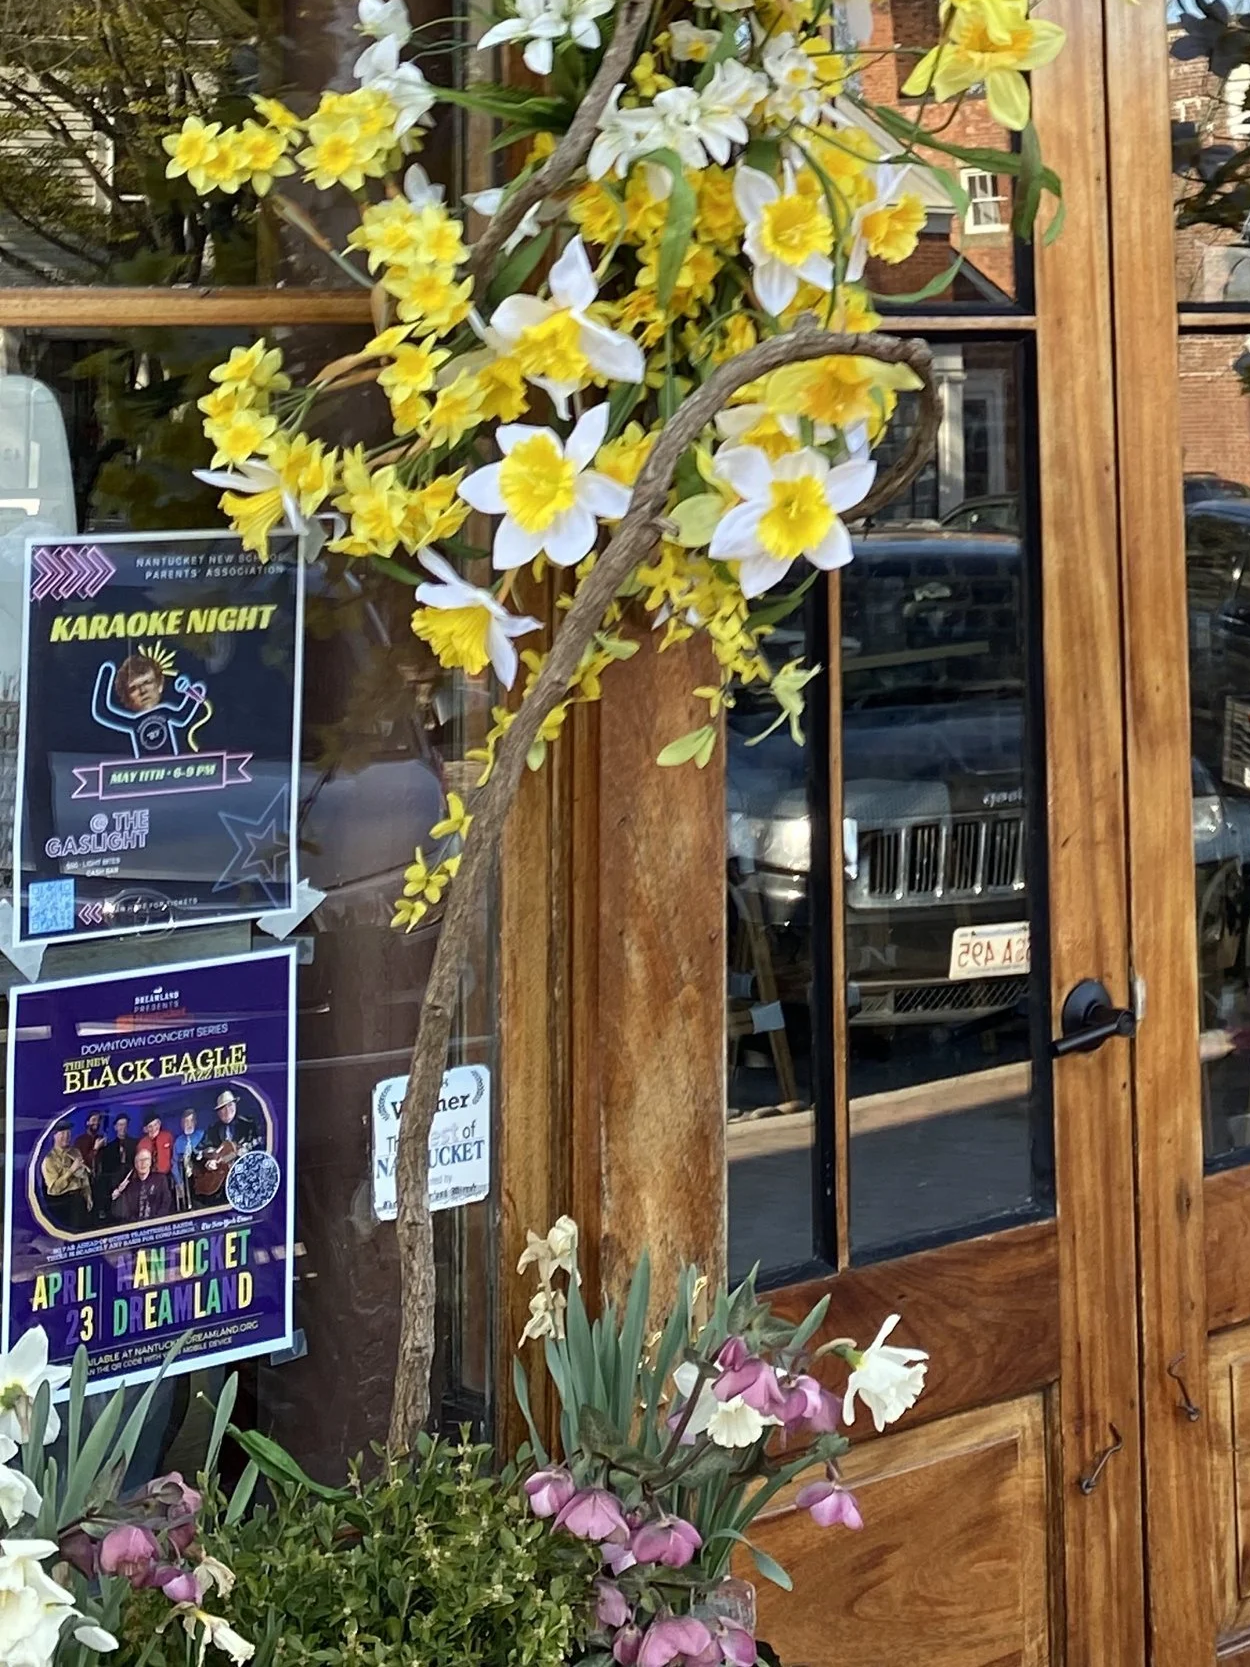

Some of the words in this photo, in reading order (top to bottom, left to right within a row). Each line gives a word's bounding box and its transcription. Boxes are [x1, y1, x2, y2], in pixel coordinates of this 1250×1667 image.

[136, 555, 203, 567] NANTUCKET
[208, 554, 235, 565] NEW
[206, 565, 284, 577] ASSOCIATION
[50, 608, 185, 643] KARAOKE
[185, 604, 277, 634] NIGHT
[109, 770, 138, 786] MAY
[172, 766, 195, 780] 6-9
[195, 764, 217, 778] PM
[112, 809, 150, 831] THE
[45, 832, 149, 859] GASLIGHT
[133, 1000, 180, 1013] PRESENTS
[134, 991, 179, 1005] DREAMLAND
[81, 1037, 146, 1055] DOWNTOWN
[147, 1028, 196, 1046] CONCERT
[196, 1022, 228, 1038] SERIES
[63, 1059, 86, 1072] THE
[86, 1055, 111, 1067] NEW
[63, 1057, 154, 1094] BLACK
[159, 1043, 247, 1075] EAGLE
[181, 1067, 213, 1085] JAZZ
[213, 1063, 248, 1080] BAND
[431, 1122, 459, 1147] est
[462, 1119, 477, 1139] of
[117, 1230, 252, 1287] NANTUCKET
[31, 1268, 97, 1314] APRIL
[113, 1271, 253, 1337] DREAMLAND
[65, 1306, 94, 1346] 23
[97, 1365, 110, 1375] THE
[123, 1359, 143, 1369] CODE
[143, 1354, 162, 1365] WITH
[182, 1343, 207, 1354] MOBILE
[208, 1337, 232, 1349] DEVICE
[121, 1349, 133, 1359] AT
